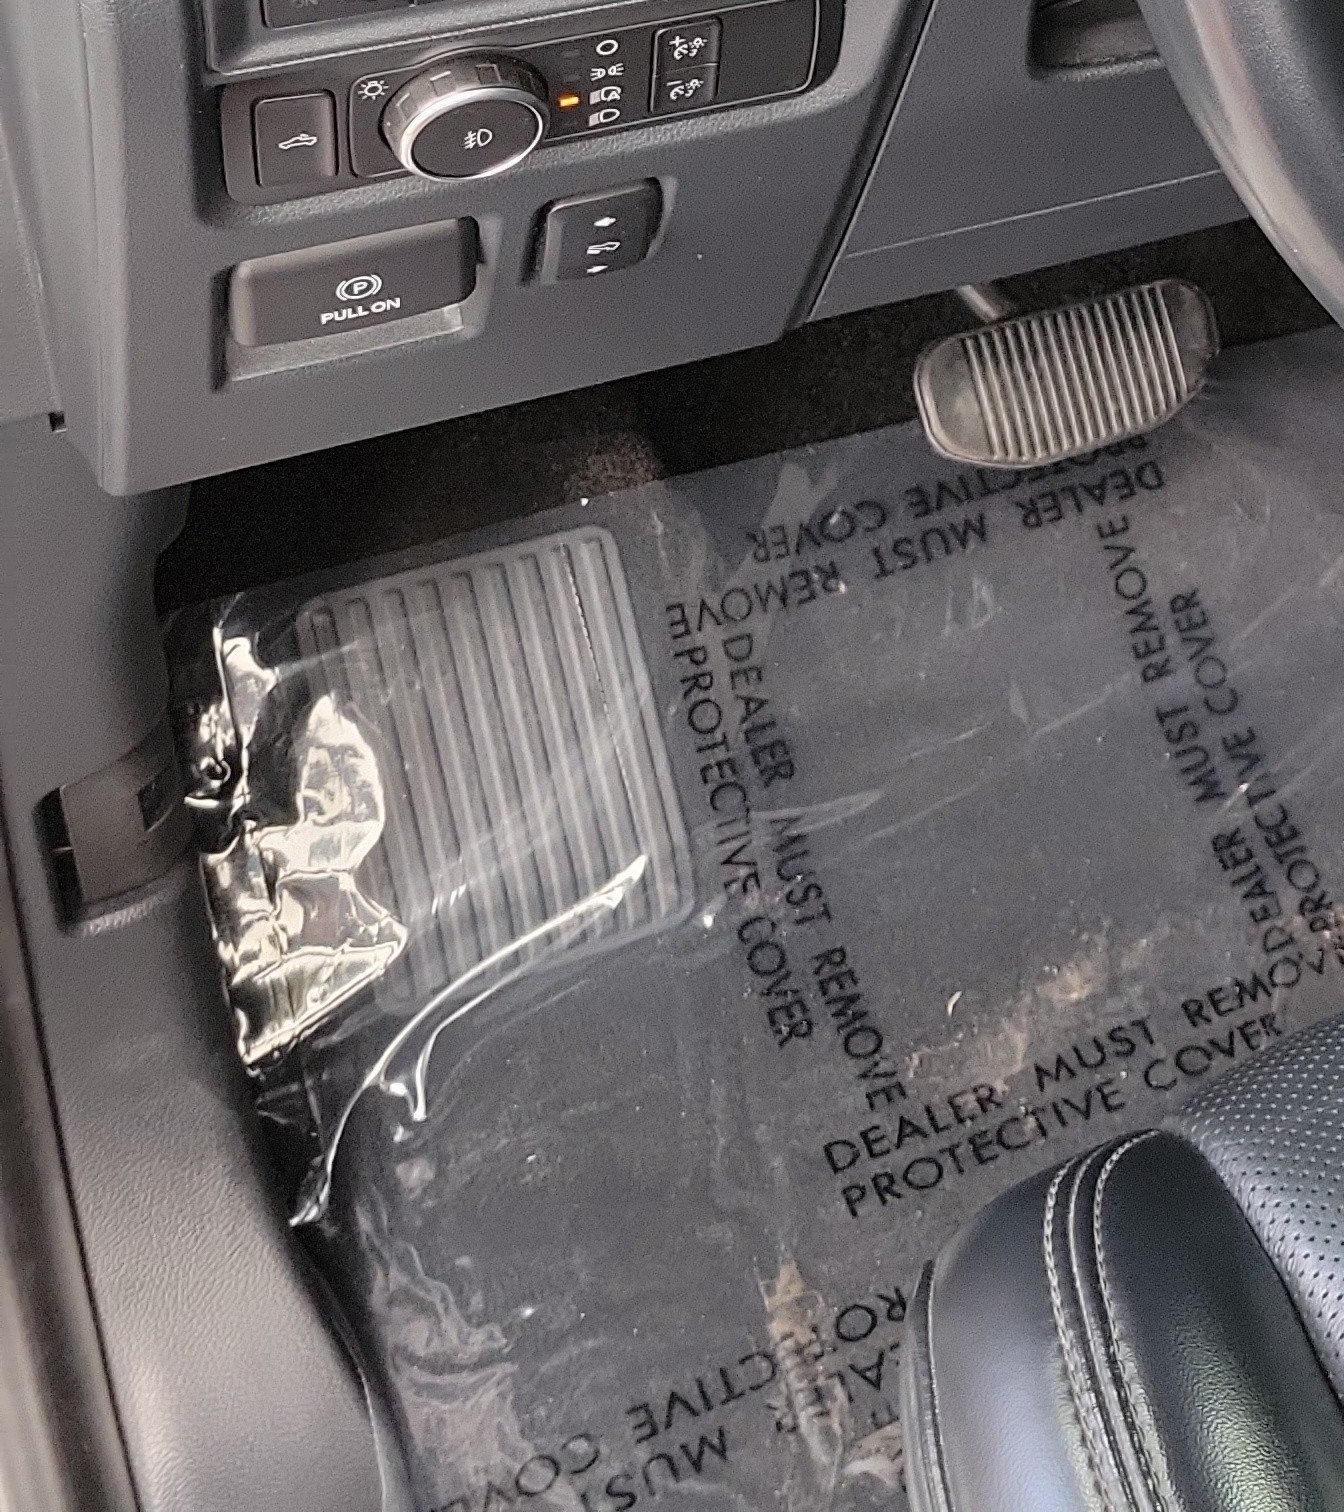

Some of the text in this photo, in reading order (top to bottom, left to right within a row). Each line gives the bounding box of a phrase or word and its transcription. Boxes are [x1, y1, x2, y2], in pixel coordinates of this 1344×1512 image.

[320, 297, 401, 325] PULL ON
[665, 460, 1165, 640] DEALER MUST REMOVE
[745, 498, 886, 563] COVER
[1096, 515, 1295, 955] DEALER MUST REMOVE
[1169, 588, 1239, 716] COVER
[673, 645, 814, 1048] PROTECTIVE COVER
[722, 632, 908, 1111] DEALER MUST REMOVE
[822, 1082, 1003, 1176] DEALER
[1033, 1017, 1157, 1092] MUST
[840, 1011, 1283, 1218] PROTECTIVE COVER
